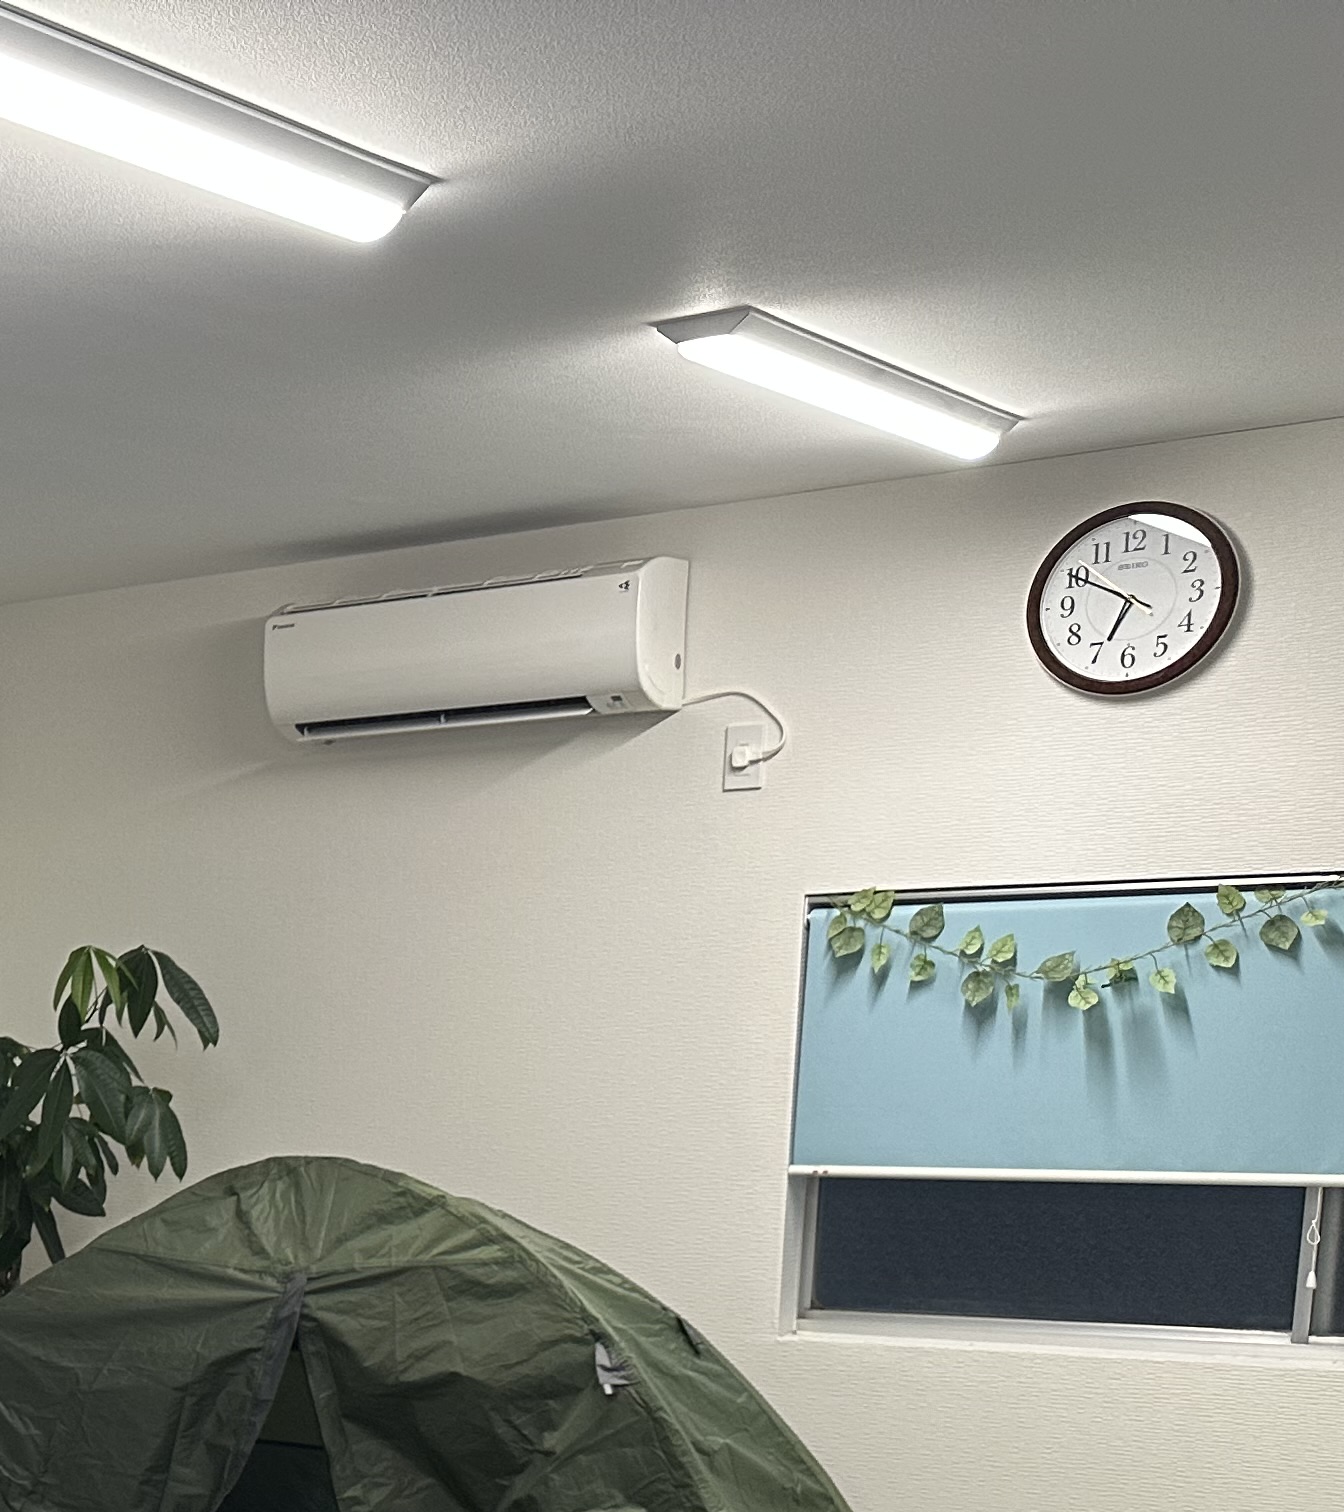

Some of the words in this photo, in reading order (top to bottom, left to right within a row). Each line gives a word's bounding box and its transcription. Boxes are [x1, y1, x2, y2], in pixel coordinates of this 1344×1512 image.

[1122, 529, 1147, 553] 12
[1162, 534, 1171, 555] 1
[1092, 542, 1111, 564] 11
[1181, 551, 1198, 574] 2
[1066, 566, 1090, 589] 10
[1117, 561, 1149, 571] SEIKO
[1188, 579, 1205, 602] 3
[1060, 596, 1075, 618] 9
[1177, 609, 1194, 632] 4
[1067, 623, 1082, 645] 8
[1153, 634, 1169, 657] 5
[1089, 641, 1104, 664] 7
[1120, 645, 1136, 668] 6
